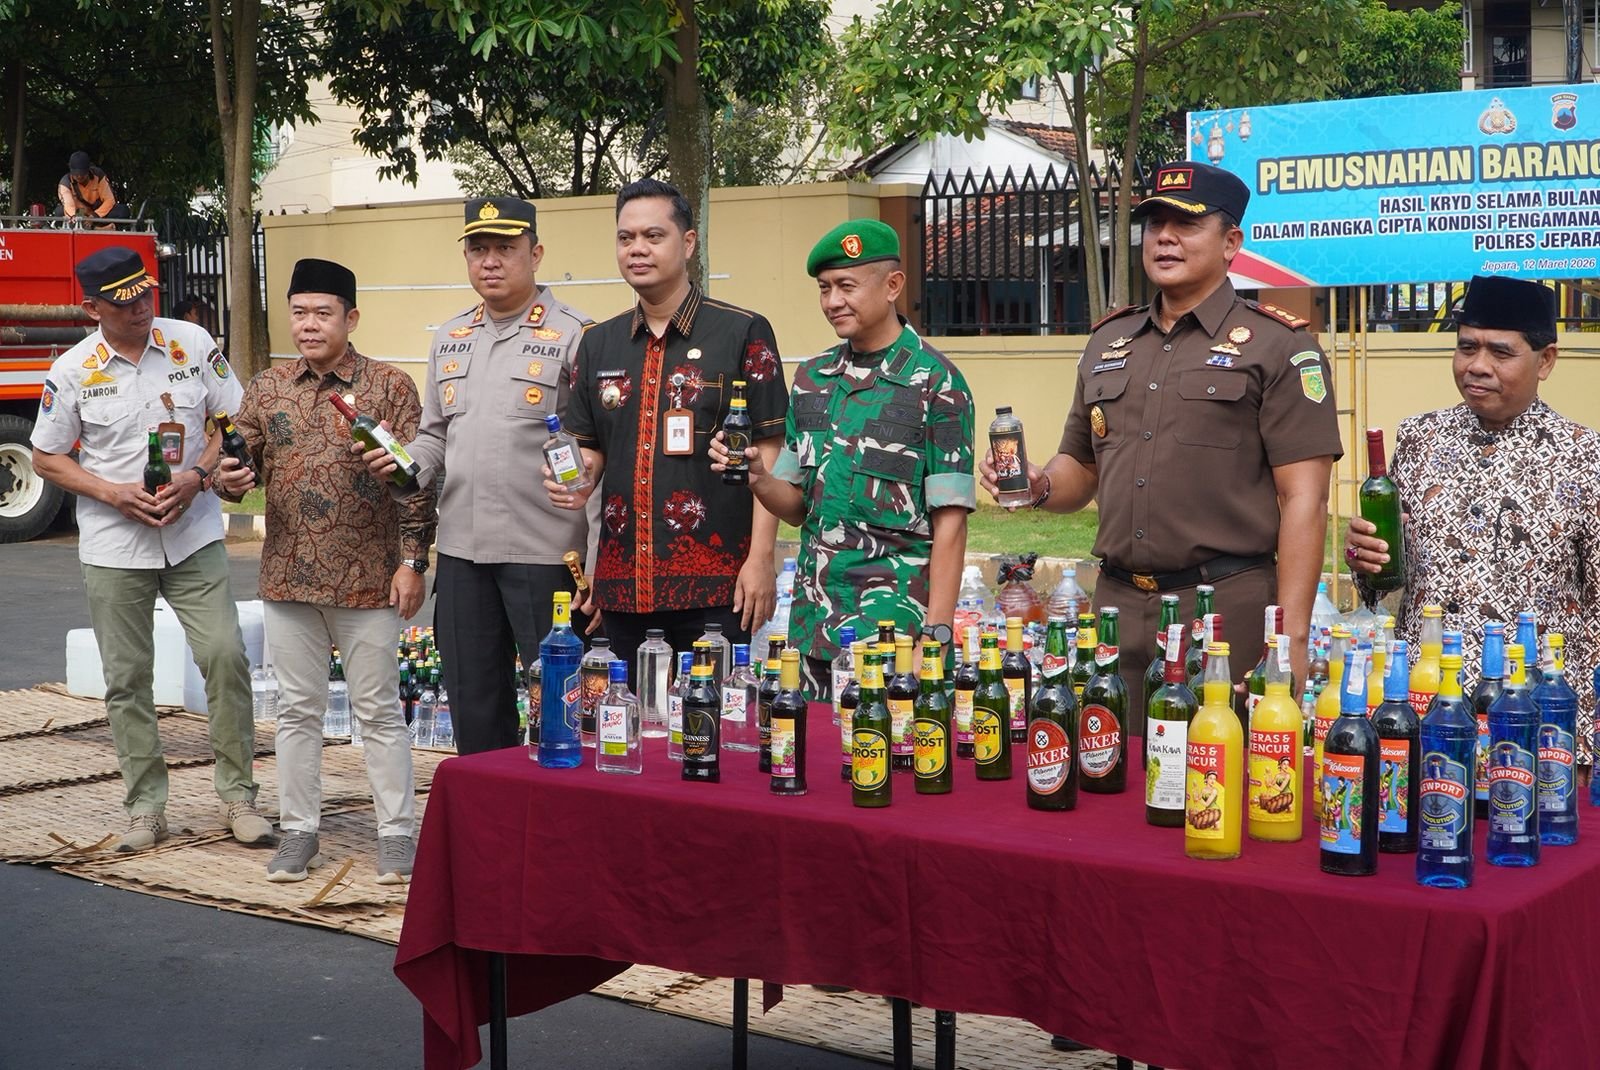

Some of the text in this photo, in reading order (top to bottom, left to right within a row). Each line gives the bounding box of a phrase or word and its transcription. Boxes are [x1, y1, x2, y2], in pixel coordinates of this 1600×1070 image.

[1259, 149, 1471, 192] PEMUSNAHAN
[1380, 189, 1600, 214] HASIL KRYD SELAMA BULAN
[1253, 210, 1600, 240] DALAM RANGKA CIPTA KONDISI PENGAMANA
[1474, 231, 1600, 250] POLRES JEPARA
[1482, 258, 1596, 272] Jepara, 12 Maret 2026
[439, 343, 472, 354] HADI
[522, 344, 561, 358] POLRI
[168, 366, 200, 383] POL PP
[82, 386, 118, 400] ZAMRONI
[871, 422, 895, 437] TNI
[1409, 703, 1429, 711] ENC
[976, 725, 998, 734] OST
[1315, 719, 1335, 728] ERAS
[682, 733, 711, 742] GUINNESS
[1282, 734, 1290, 743] &
[1188, 746, 1217, 756] RAS &
[1380, 748, 1407, 757] olesom
[1540, 750, 1571, 763] WPORT
[1188, 756, 1217, 767] NCUR
[1329, 762, 1361, 774] Kolesom
